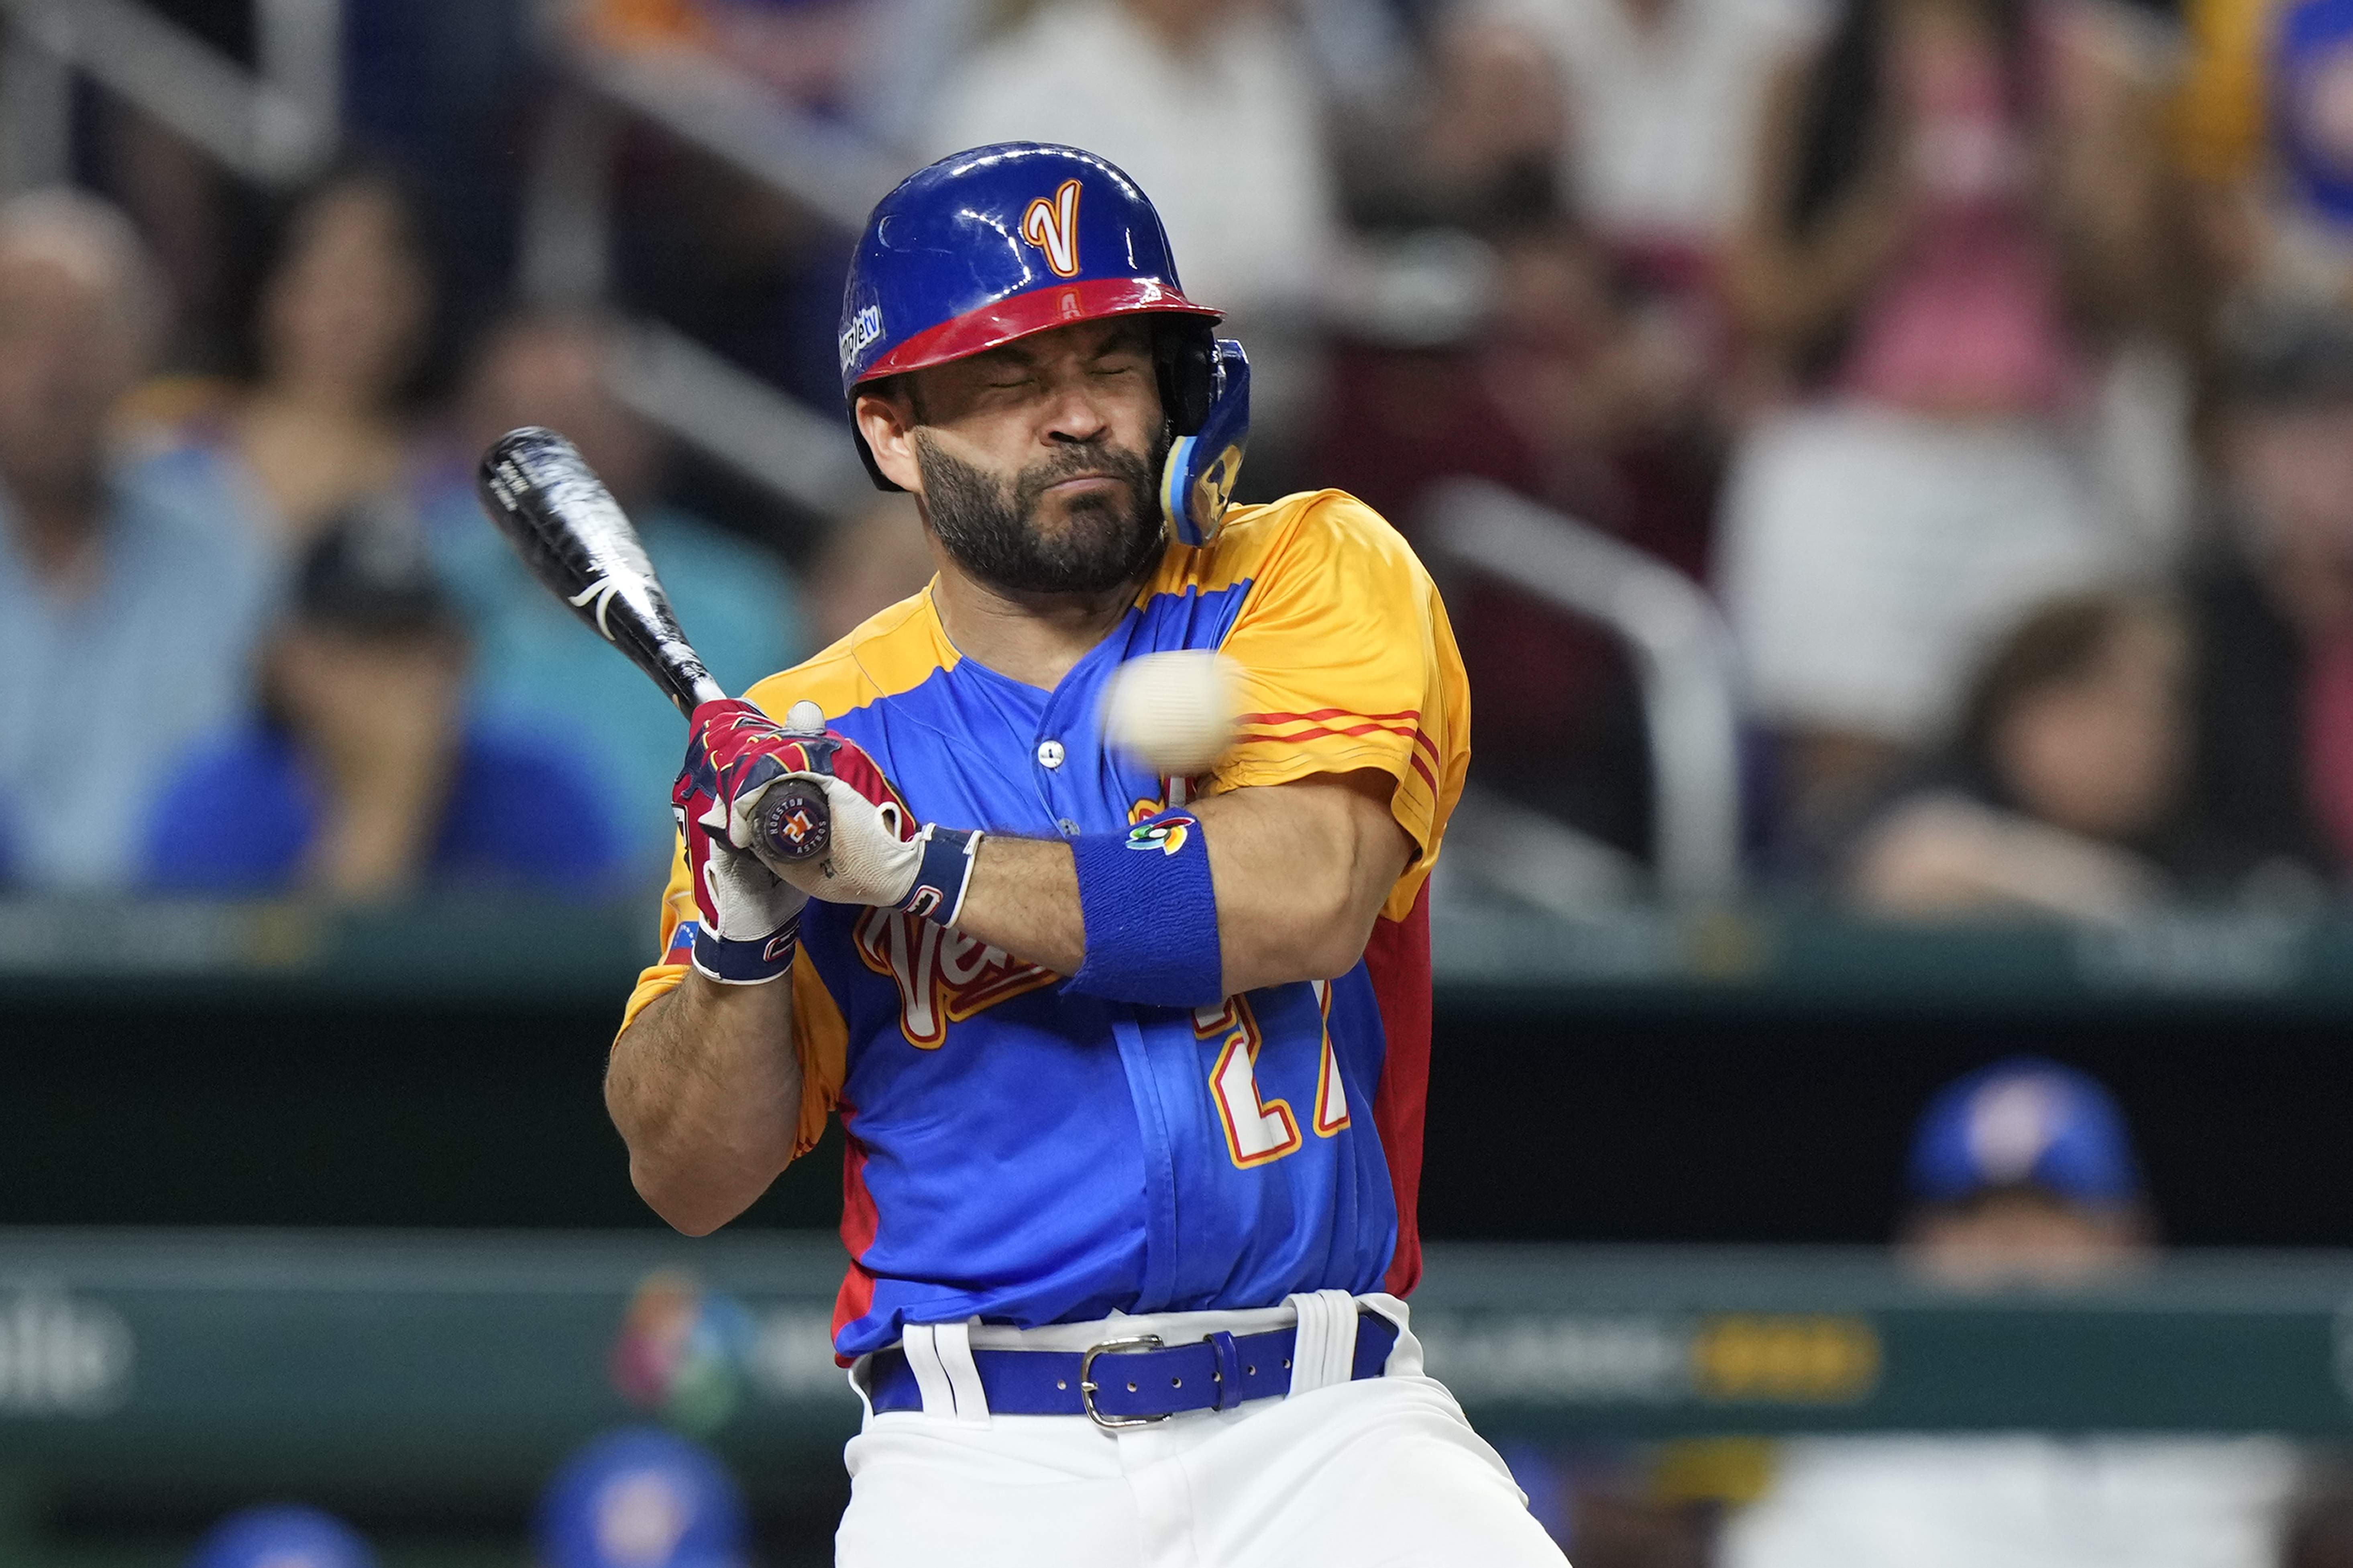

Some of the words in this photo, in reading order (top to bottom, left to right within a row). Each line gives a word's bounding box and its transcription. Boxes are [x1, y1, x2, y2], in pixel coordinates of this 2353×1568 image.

[1023, 179, 1082, 277] V
[769, 798, 803, 835] HOUSTON
[782, 809, 813, 843] 27
[797, 821, 826, 854] ASTROS
